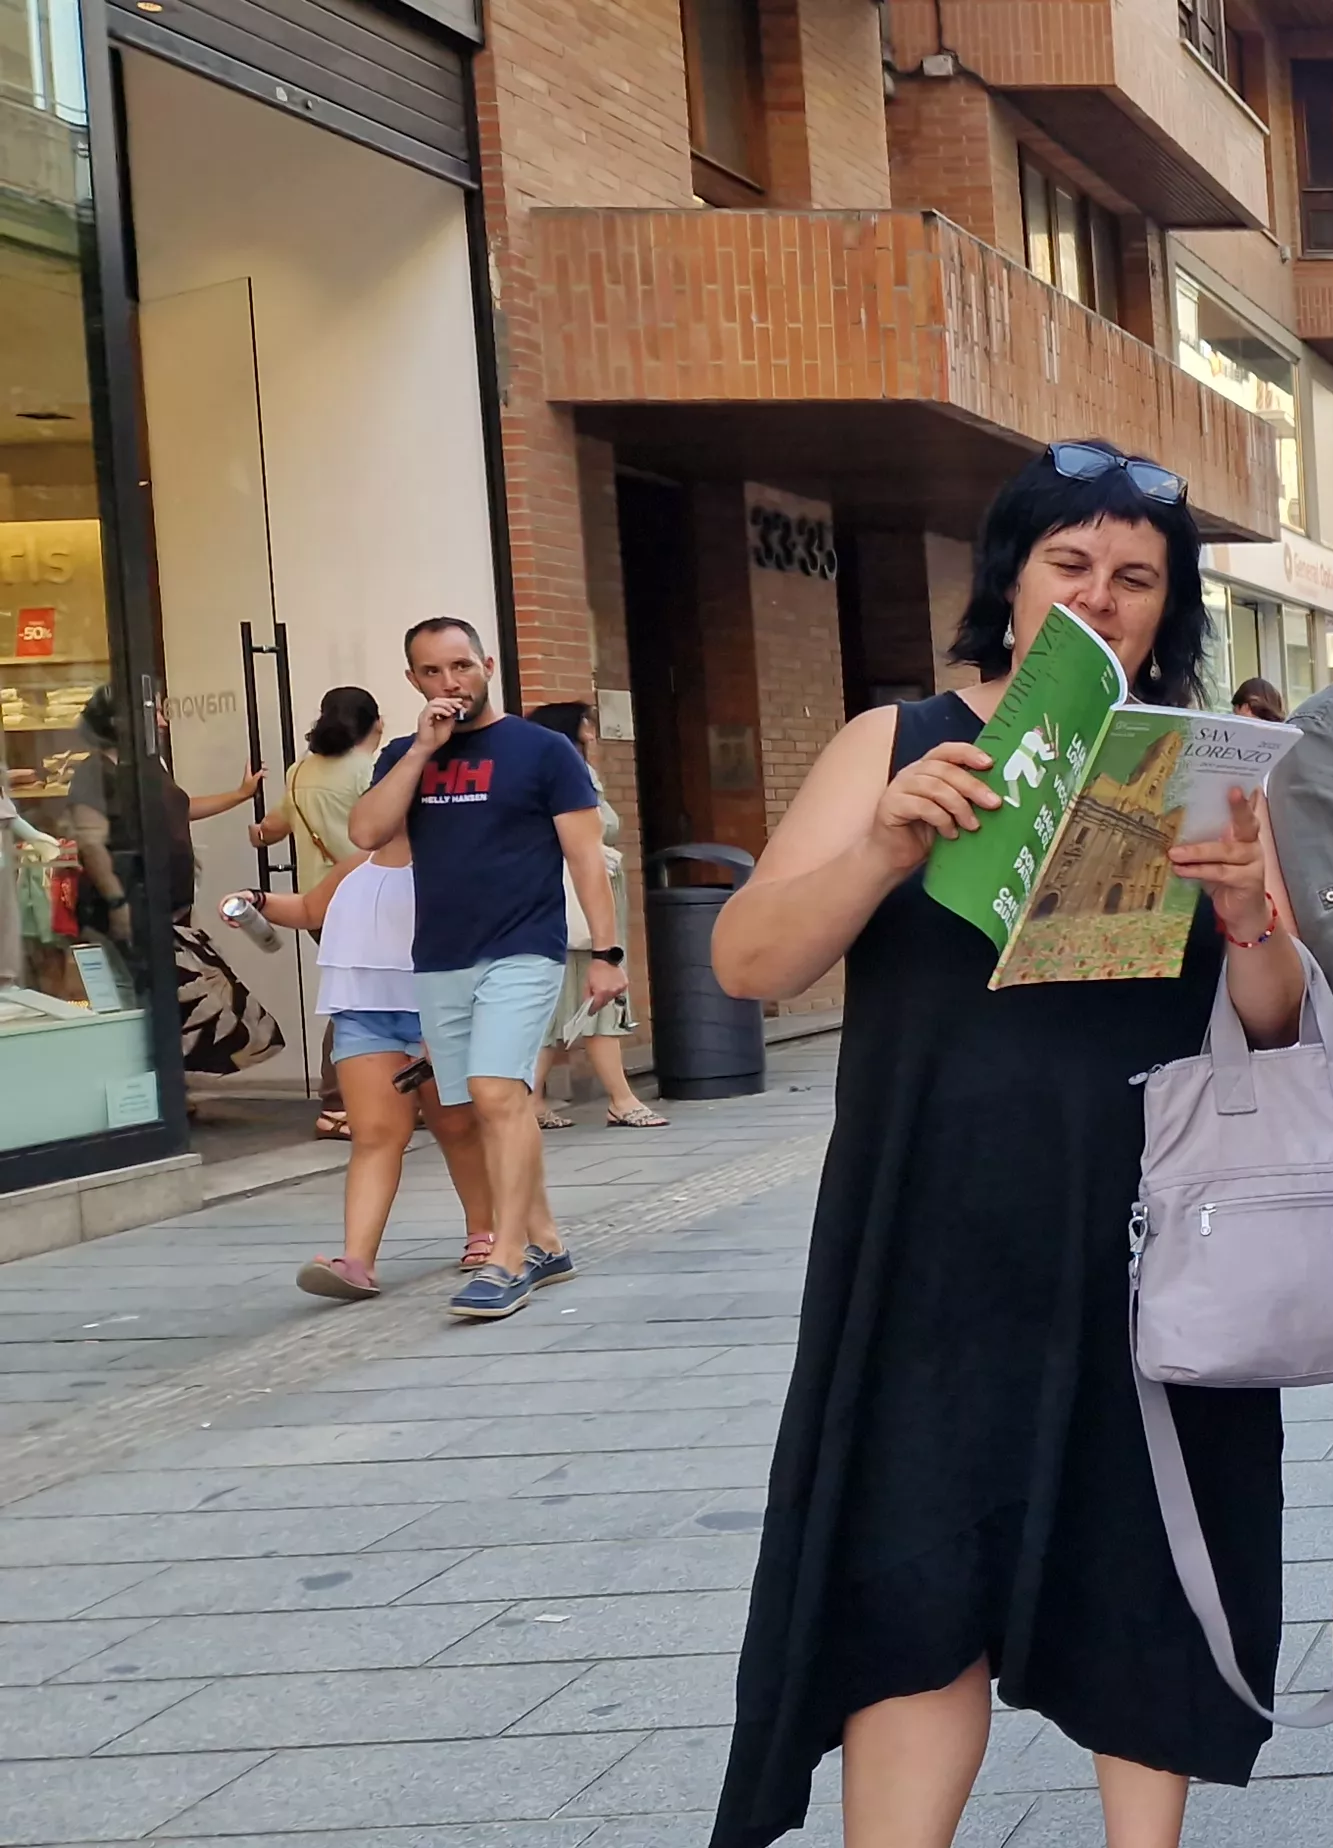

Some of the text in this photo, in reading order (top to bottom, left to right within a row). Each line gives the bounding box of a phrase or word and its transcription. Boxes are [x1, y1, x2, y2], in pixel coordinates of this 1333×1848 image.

[1194, 726, 1236, 744] SAN
[1184, 743, 1273, 764] LORENZO
[421, 792, 488, 804] HELLY HANSEN
